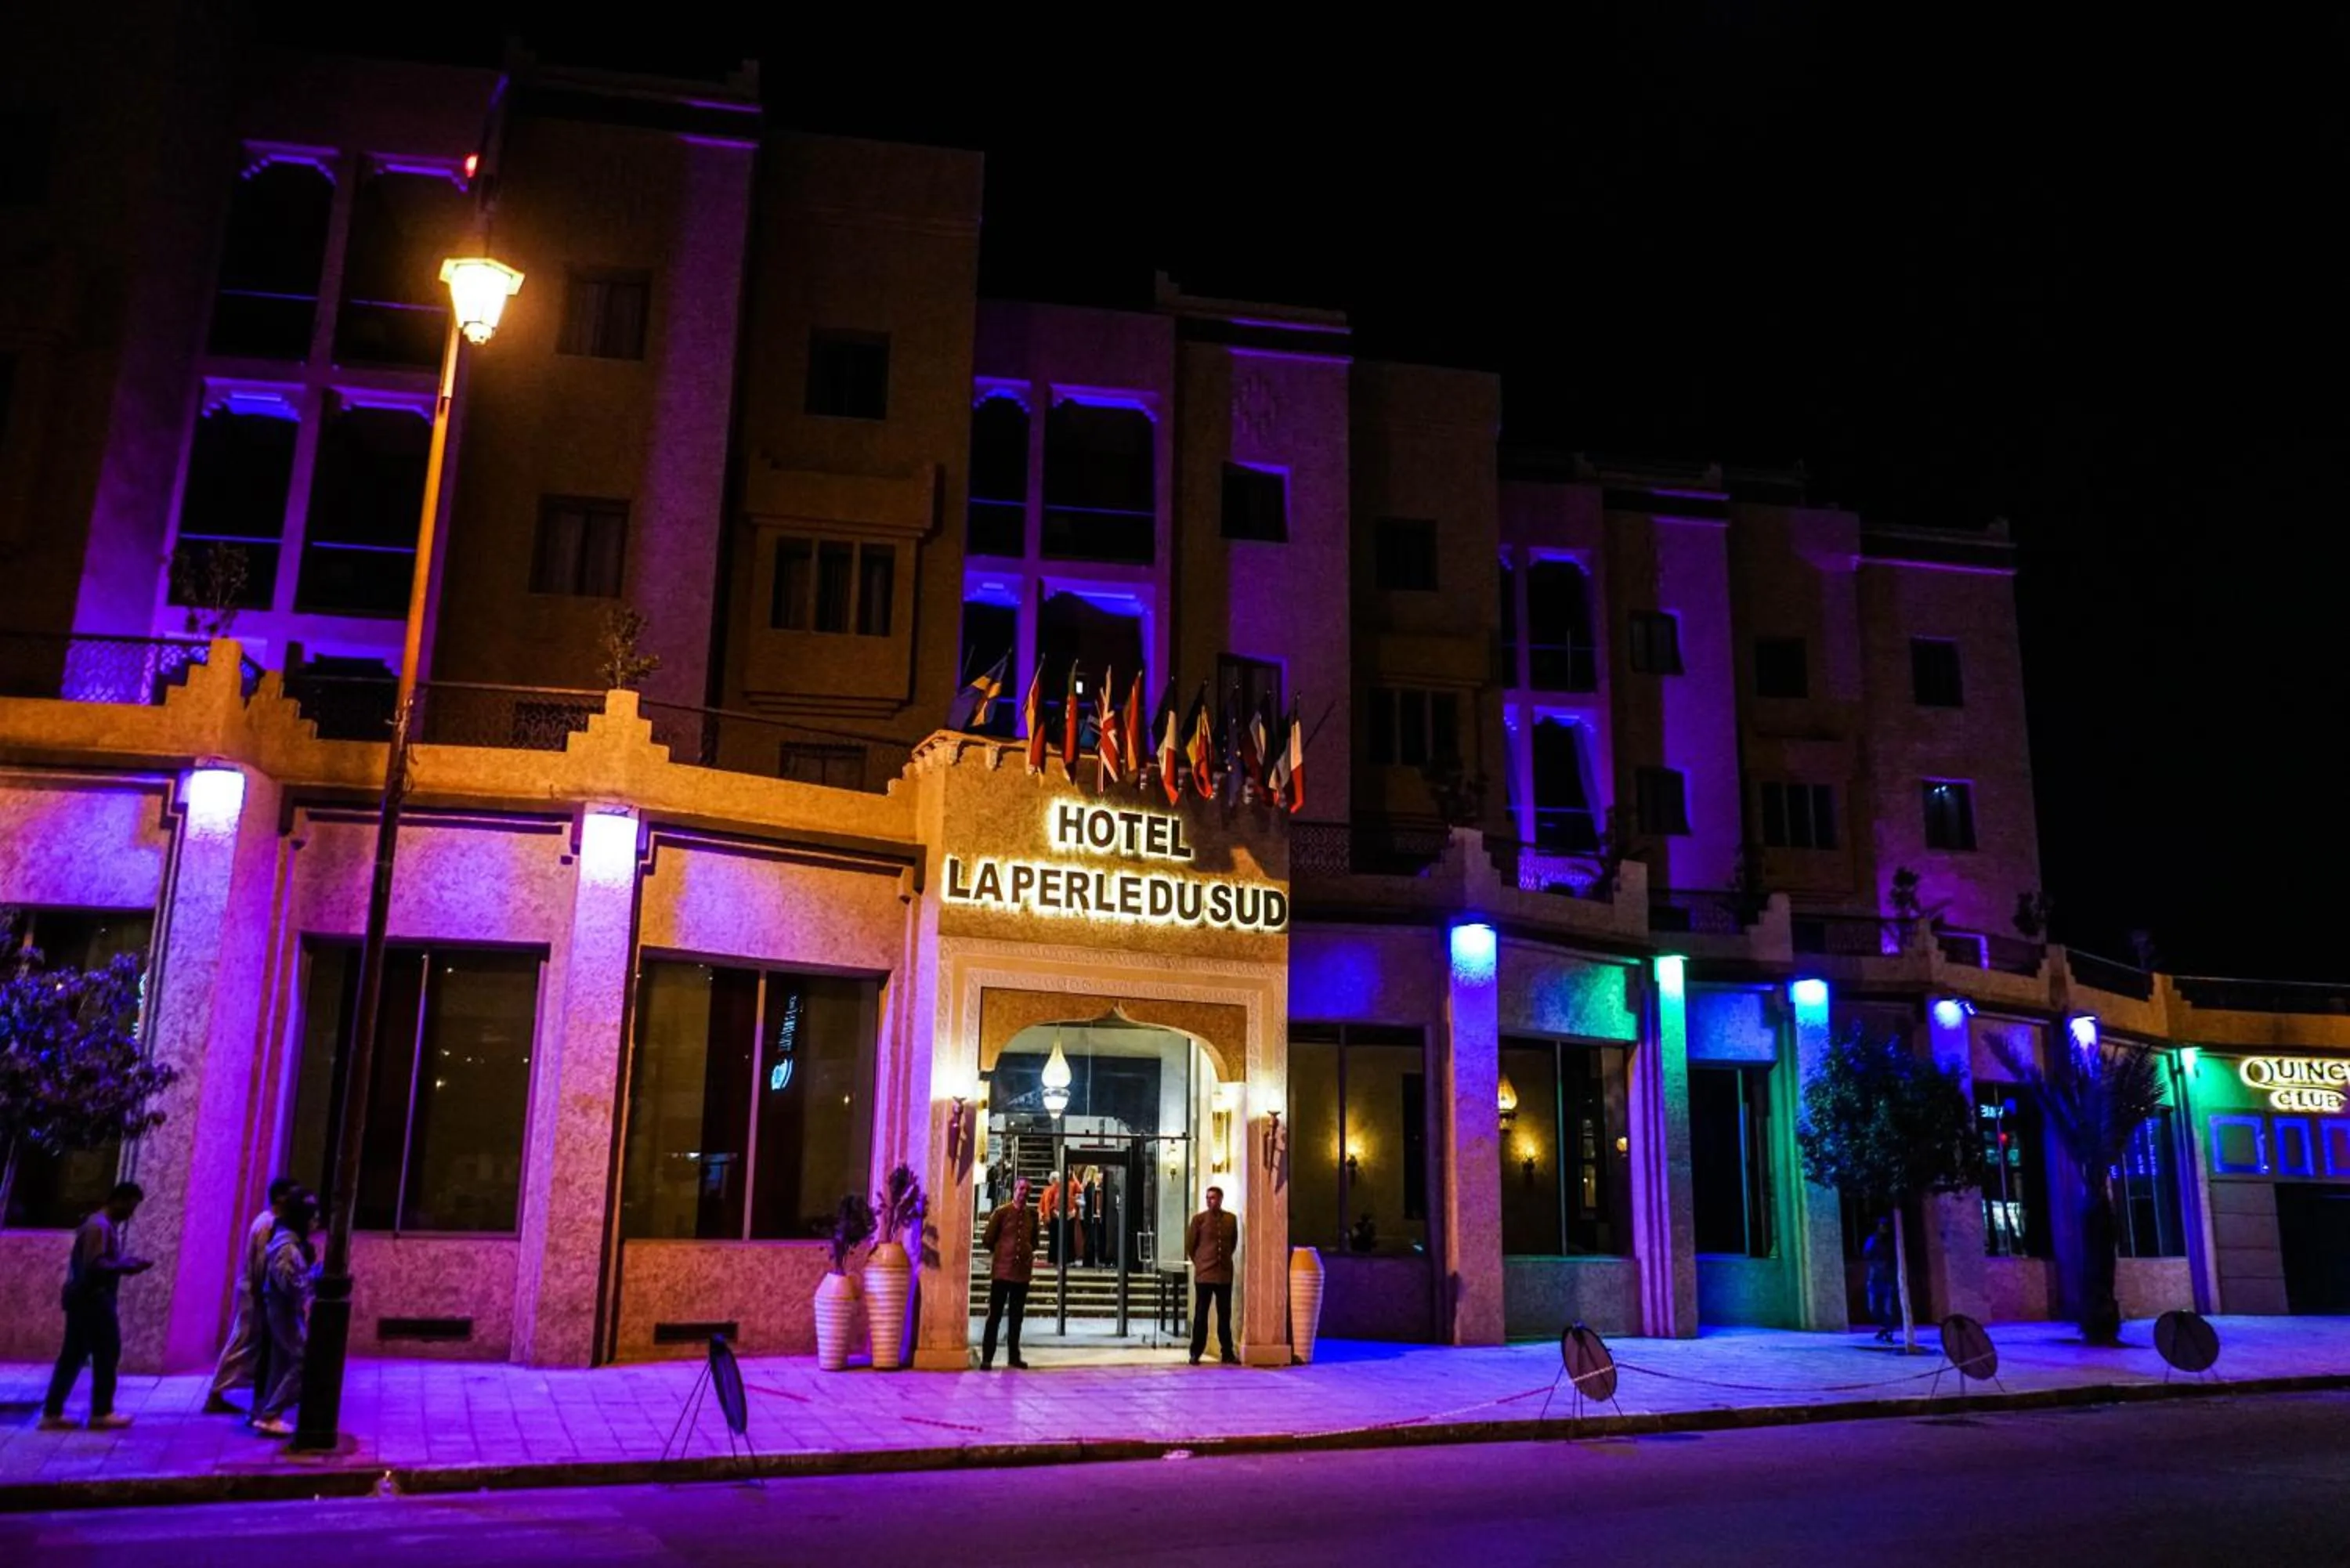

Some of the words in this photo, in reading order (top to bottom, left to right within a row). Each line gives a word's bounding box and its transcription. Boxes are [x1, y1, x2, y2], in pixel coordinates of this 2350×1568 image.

[1058, 804, 1192, 858] HOTEL
[946, 858, 1003, 903] LA
[1010, 865, 1144, 917] PERLE
[1148, 879, 1203, 922] DU
[1209, 883, 1288, 928] SUD
[2243, 1058, 2350, 1087] QUINC
[2276, 1089, 2343, 1108] CLUB
